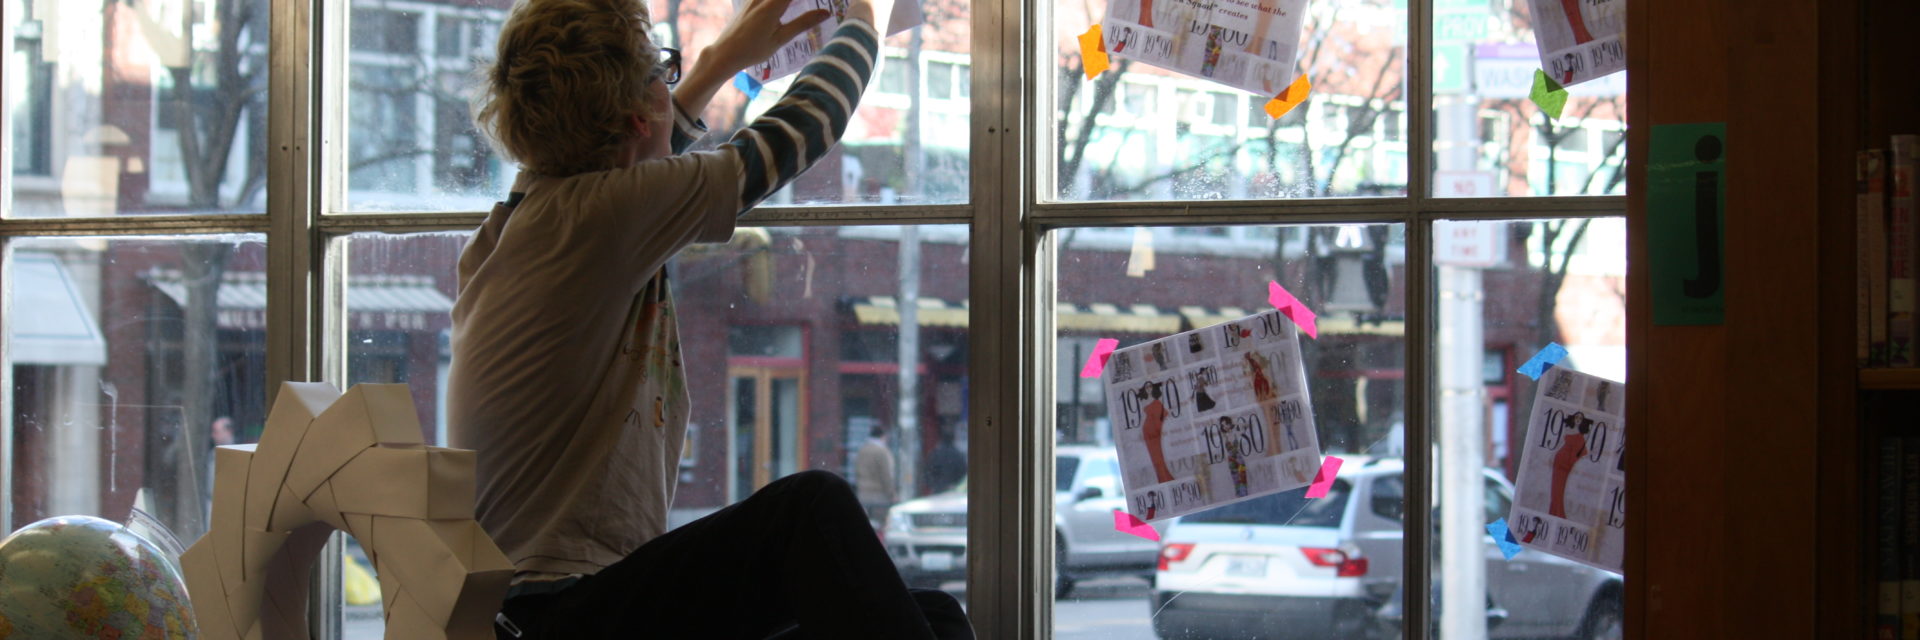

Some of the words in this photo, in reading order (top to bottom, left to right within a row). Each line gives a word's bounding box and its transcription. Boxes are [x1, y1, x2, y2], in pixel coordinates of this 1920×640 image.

[1218, 8, 1248, 19] creates
[1251, 3, 1272, 13] what
[1272, 7, 1287, 17] the
[1118, 378, 1181, 431] 190
[1538, 407, 1607, 464] 190
